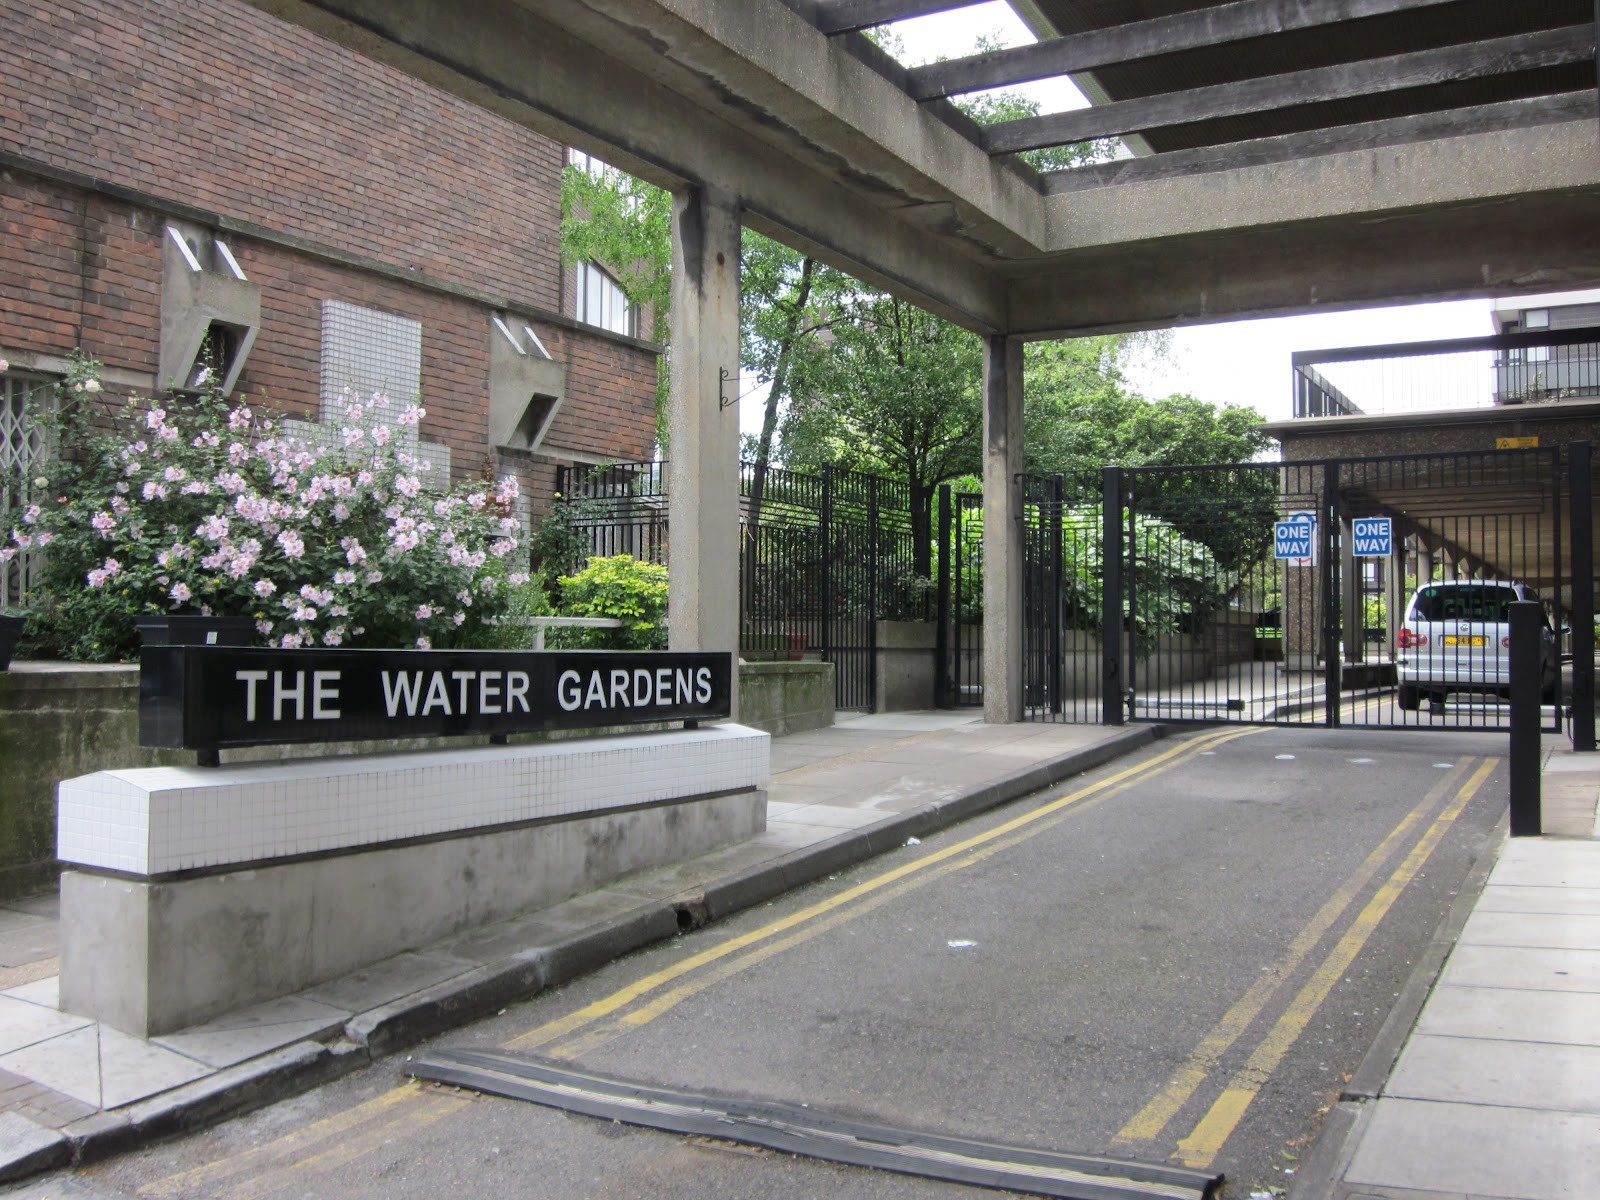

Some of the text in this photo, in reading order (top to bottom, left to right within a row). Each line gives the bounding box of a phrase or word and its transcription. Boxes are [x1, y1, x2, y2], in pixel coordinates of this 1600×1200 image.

[1277, 526, 1309, 539] ONE
[1355, 523, 1389, 536] ONE
[1277, 541, 1309, 554] WAY
[1355, 539, 1389, 552] WAY
[235, 666, 712, 722] THE WATER GARDENS
